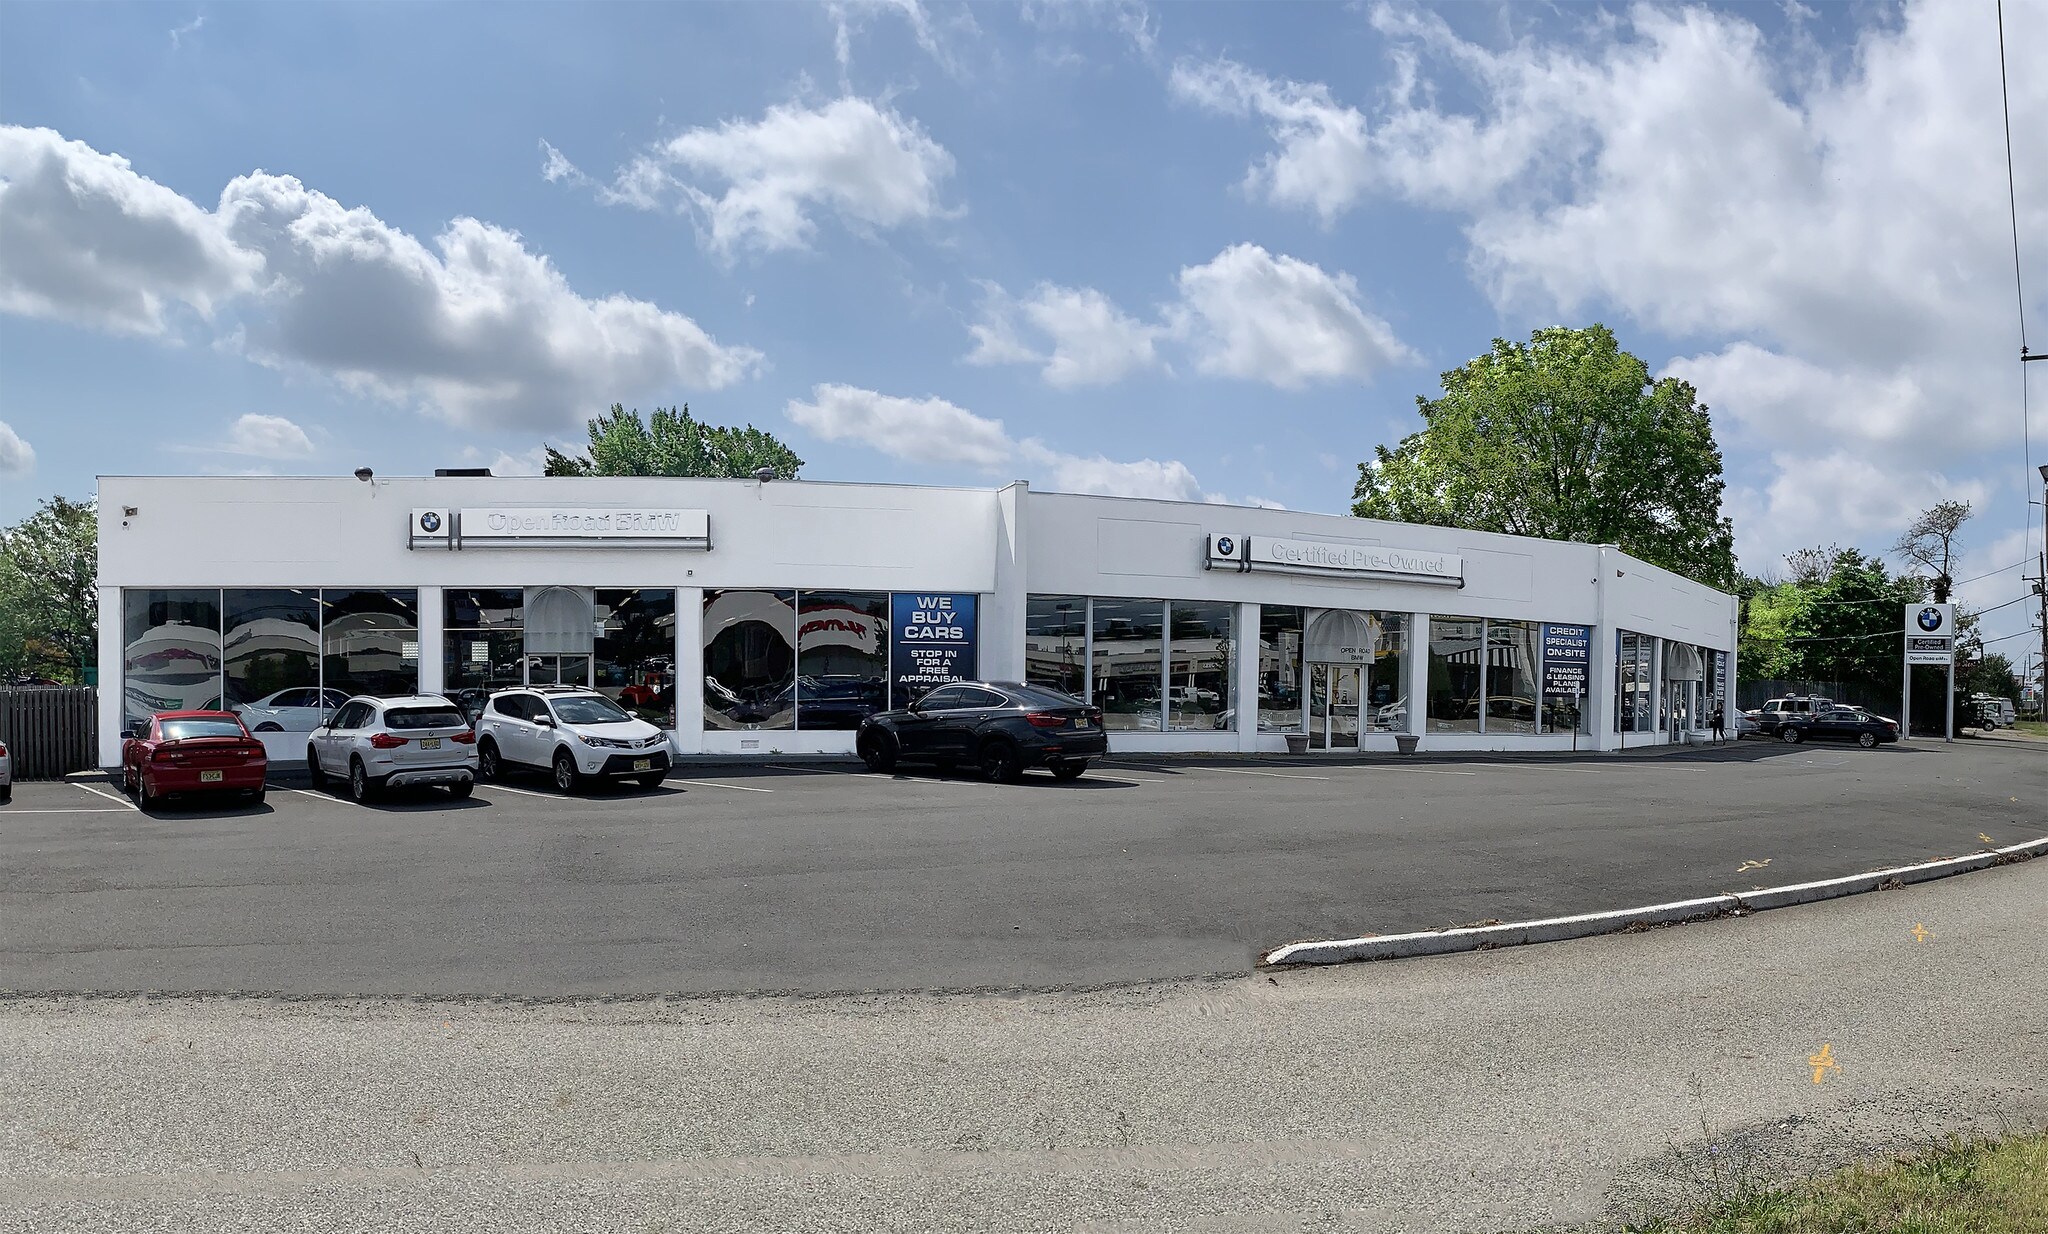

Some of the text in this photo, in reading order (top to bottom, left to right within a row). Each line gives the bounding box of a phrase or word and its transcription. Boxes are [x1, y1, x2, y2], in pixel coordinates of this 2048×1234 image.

[488, 512, 680, 533] Open Road BMW
[1271, 542, 1444, 573] Certified Pre-Owned
[916, 596, 951, 610] WE
[911, 611, 956, 624] BUY
[904, 626, 964, 640] CARS
[1549, 626, 1584, 636] CREDIT
[1545, 637, 1587, 647] SPECIALIST
[910, 649, 957, 658] STOP IN
[1547, 648, 1586, 657] ON-SITE
[916, 658, 951, 666] FOR A
[919, 666, 949, 674] FREE
[1549, 666, 1582, 674] FINANCE
[899, 675, 966, 683] APPRAISAL
